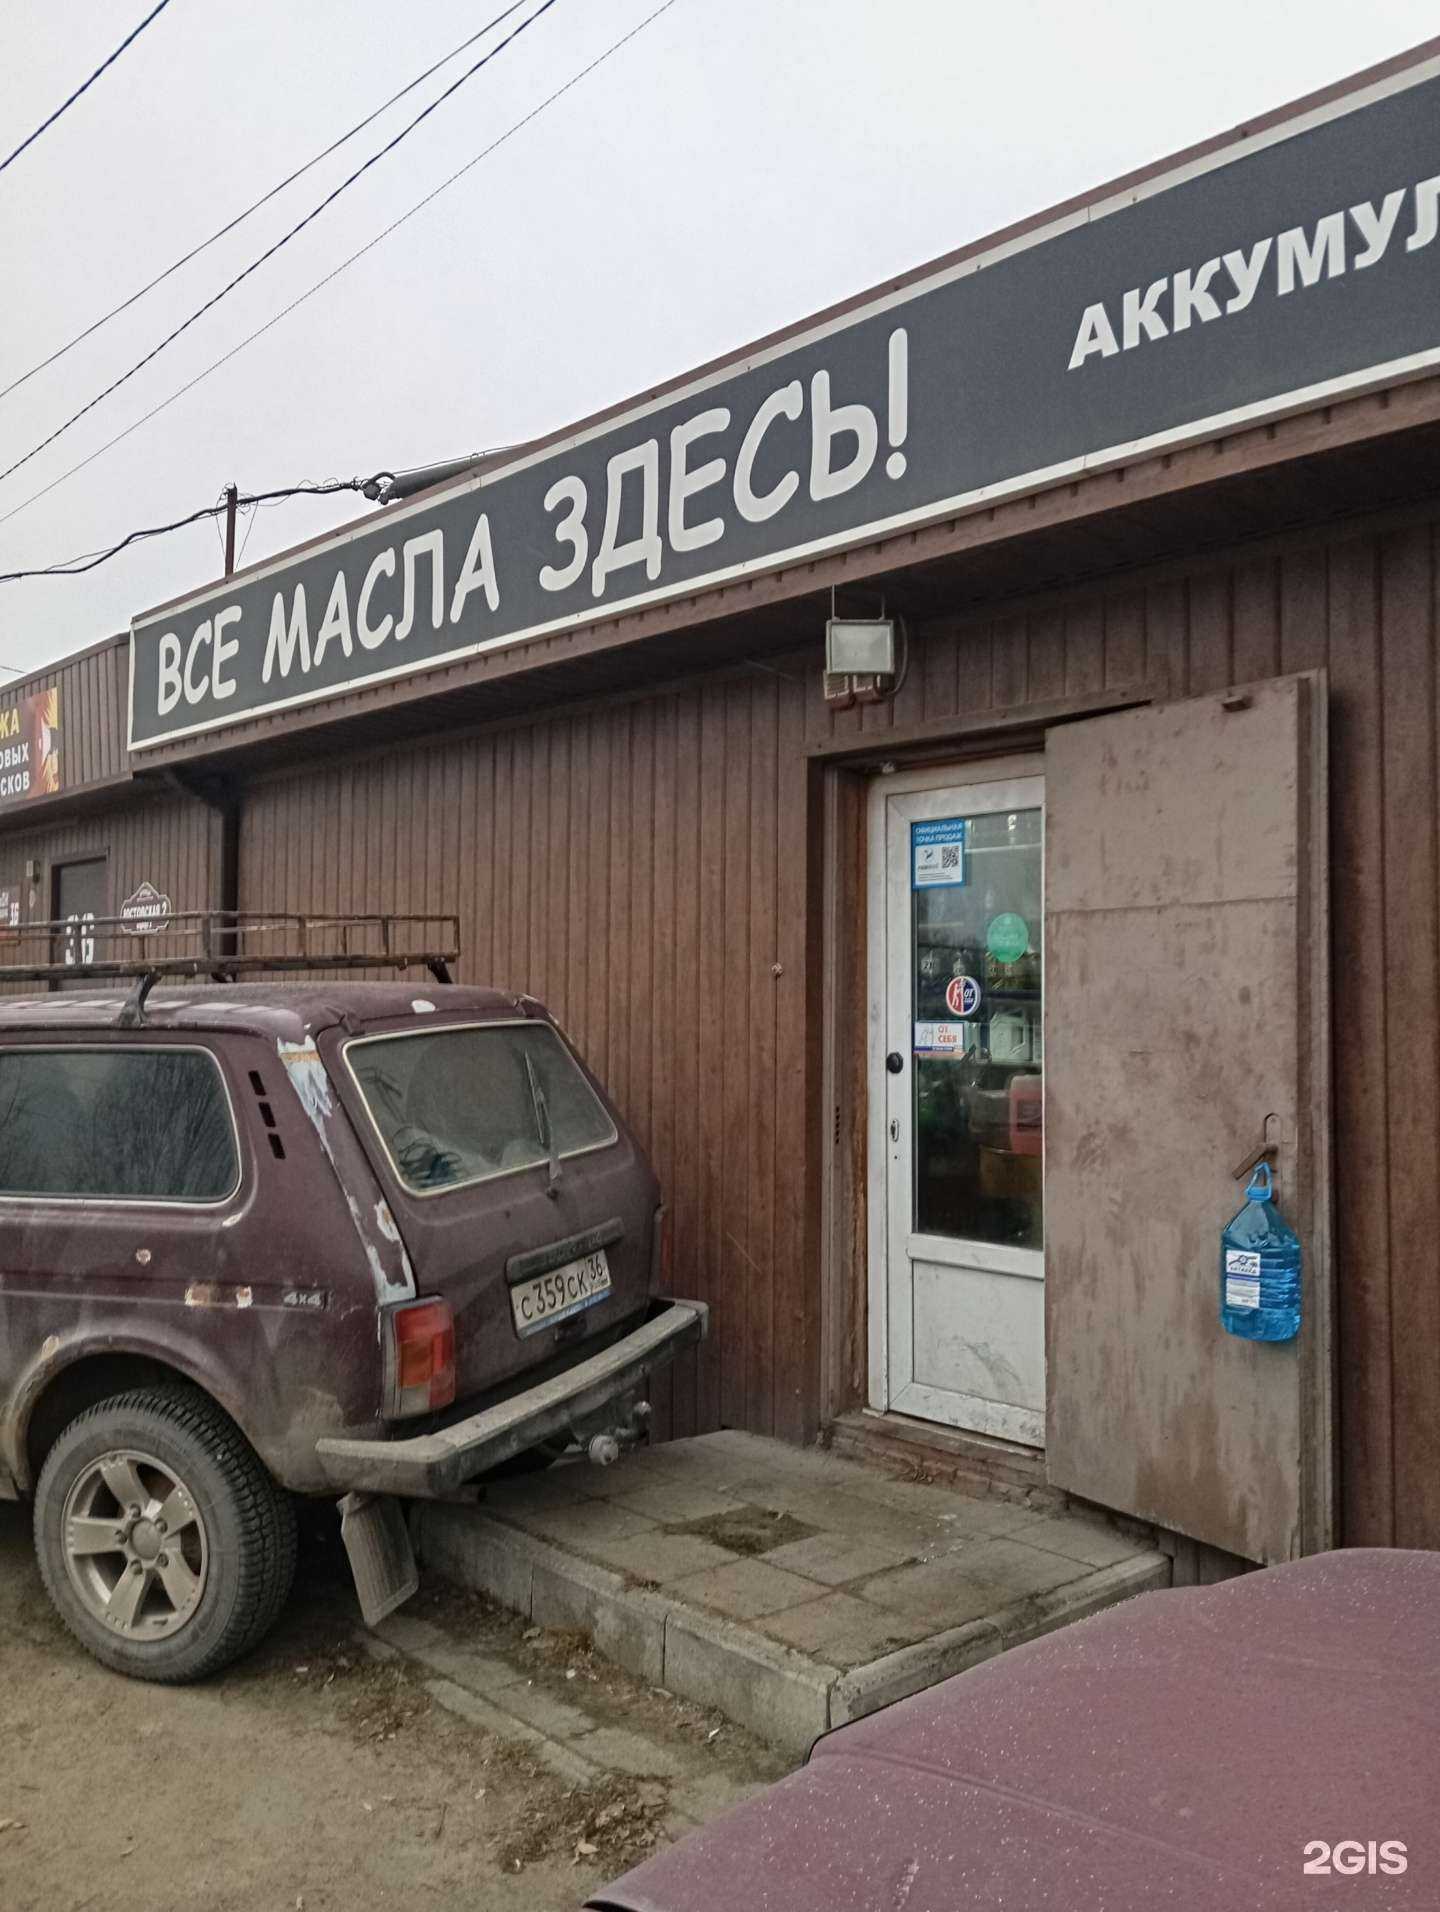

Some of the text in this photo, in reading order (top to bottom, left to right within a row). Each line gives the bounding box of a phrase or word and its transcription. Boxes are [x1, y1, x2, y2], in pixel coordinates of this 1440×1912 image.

[157, 327, 908, 716] ВСЕ МАСЛА ЗДЕСЬ!
